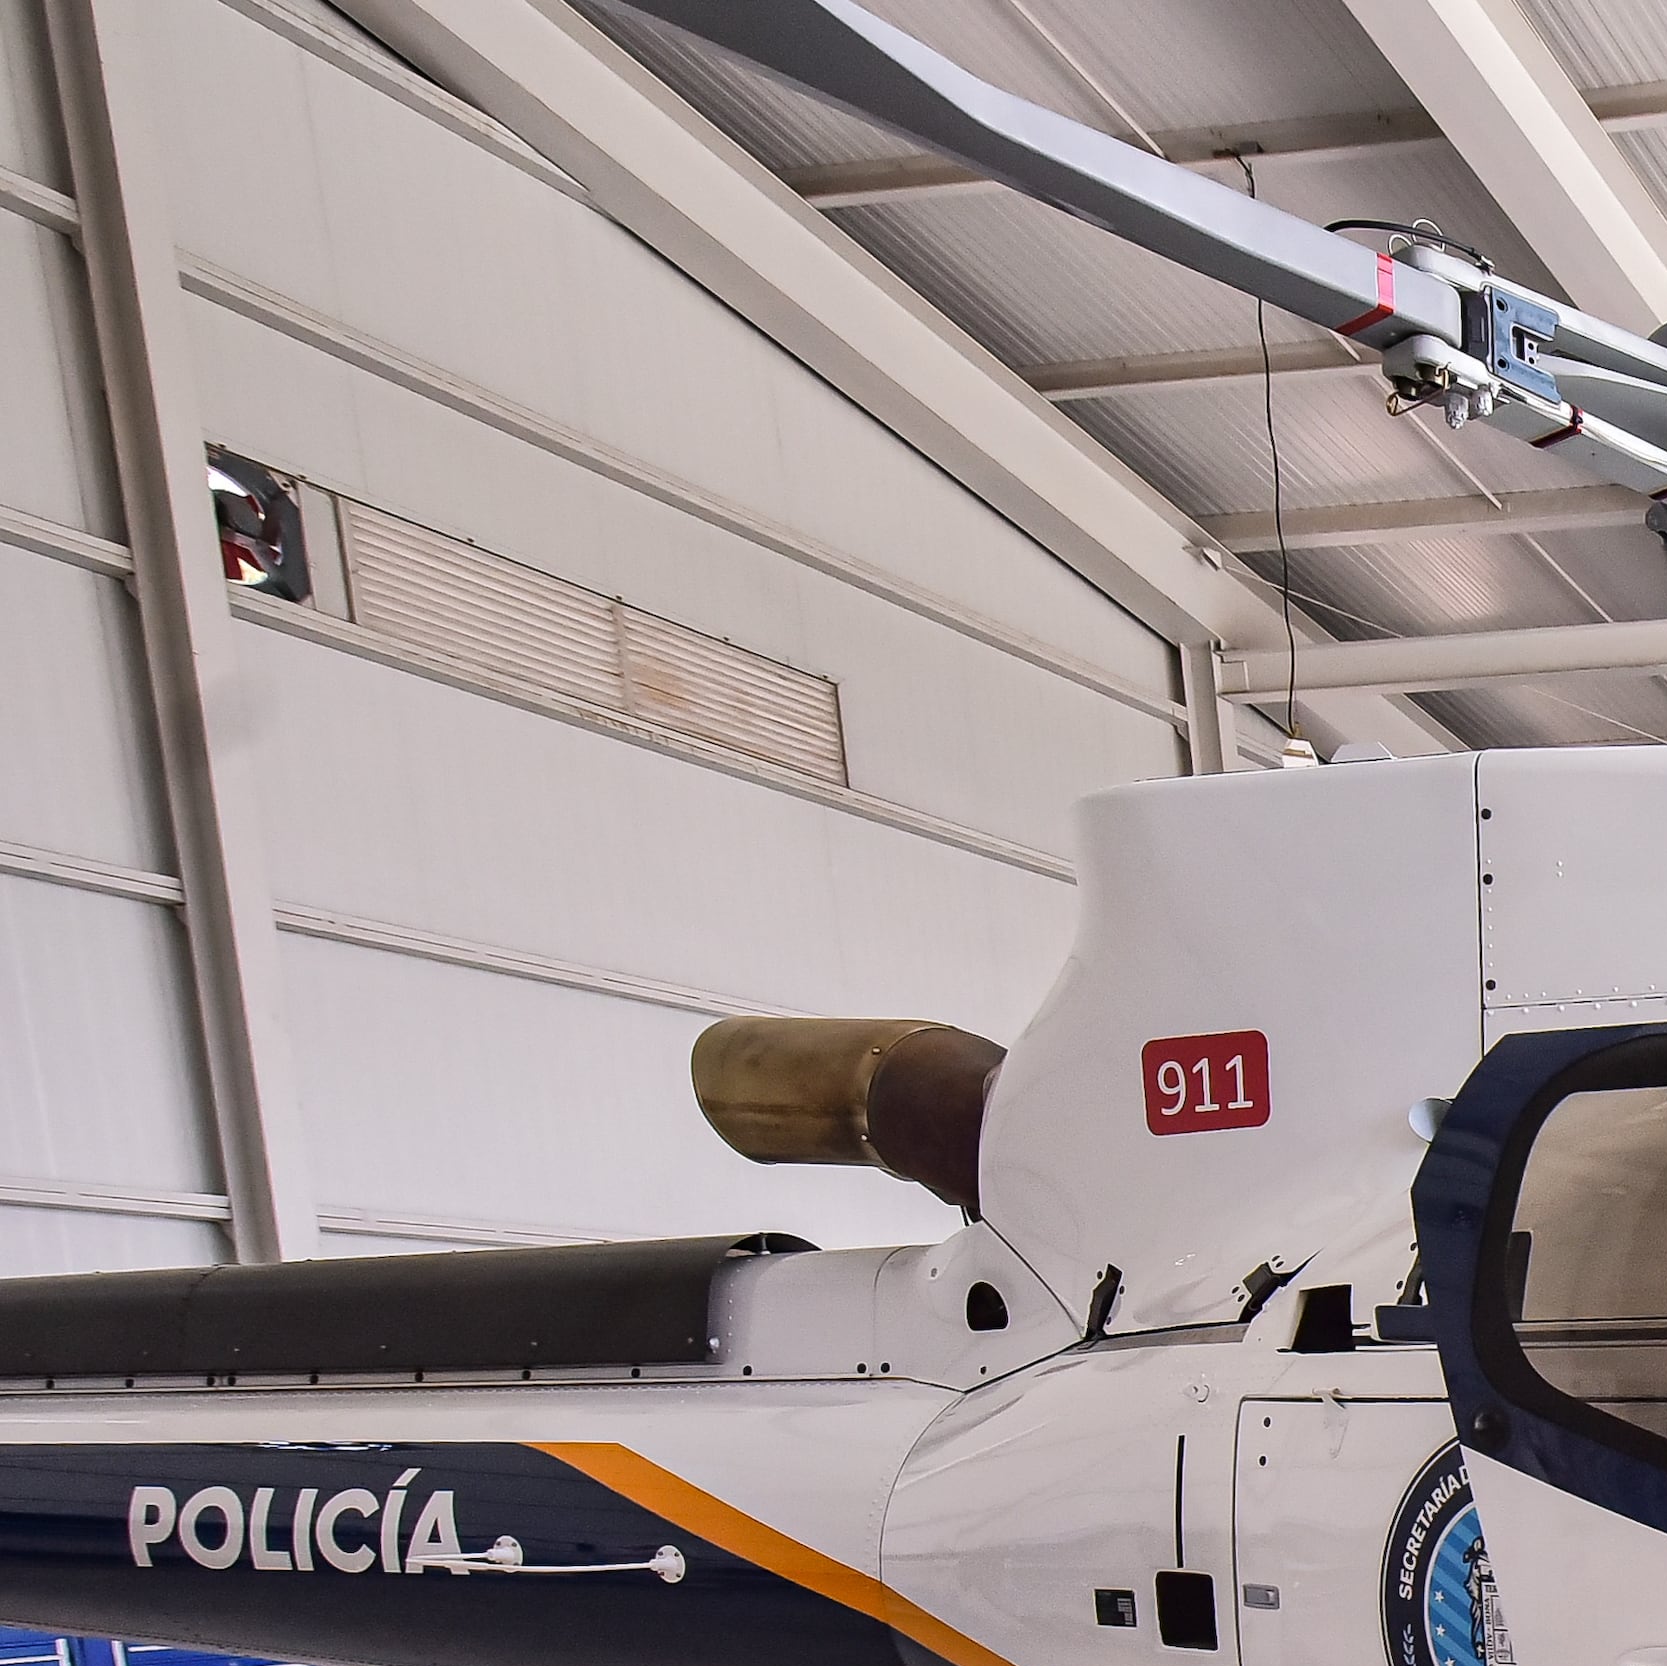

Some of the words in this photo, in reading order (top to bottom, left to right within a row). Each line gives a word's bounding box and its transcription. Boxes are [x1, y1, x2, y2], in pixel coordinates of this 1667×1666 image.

[1157, 1054, 1254, 1116] 911
[128, 1466, 471, 1575] POLICÍA
[1398, 1474, 1462, 1601] SECRETARÍA
